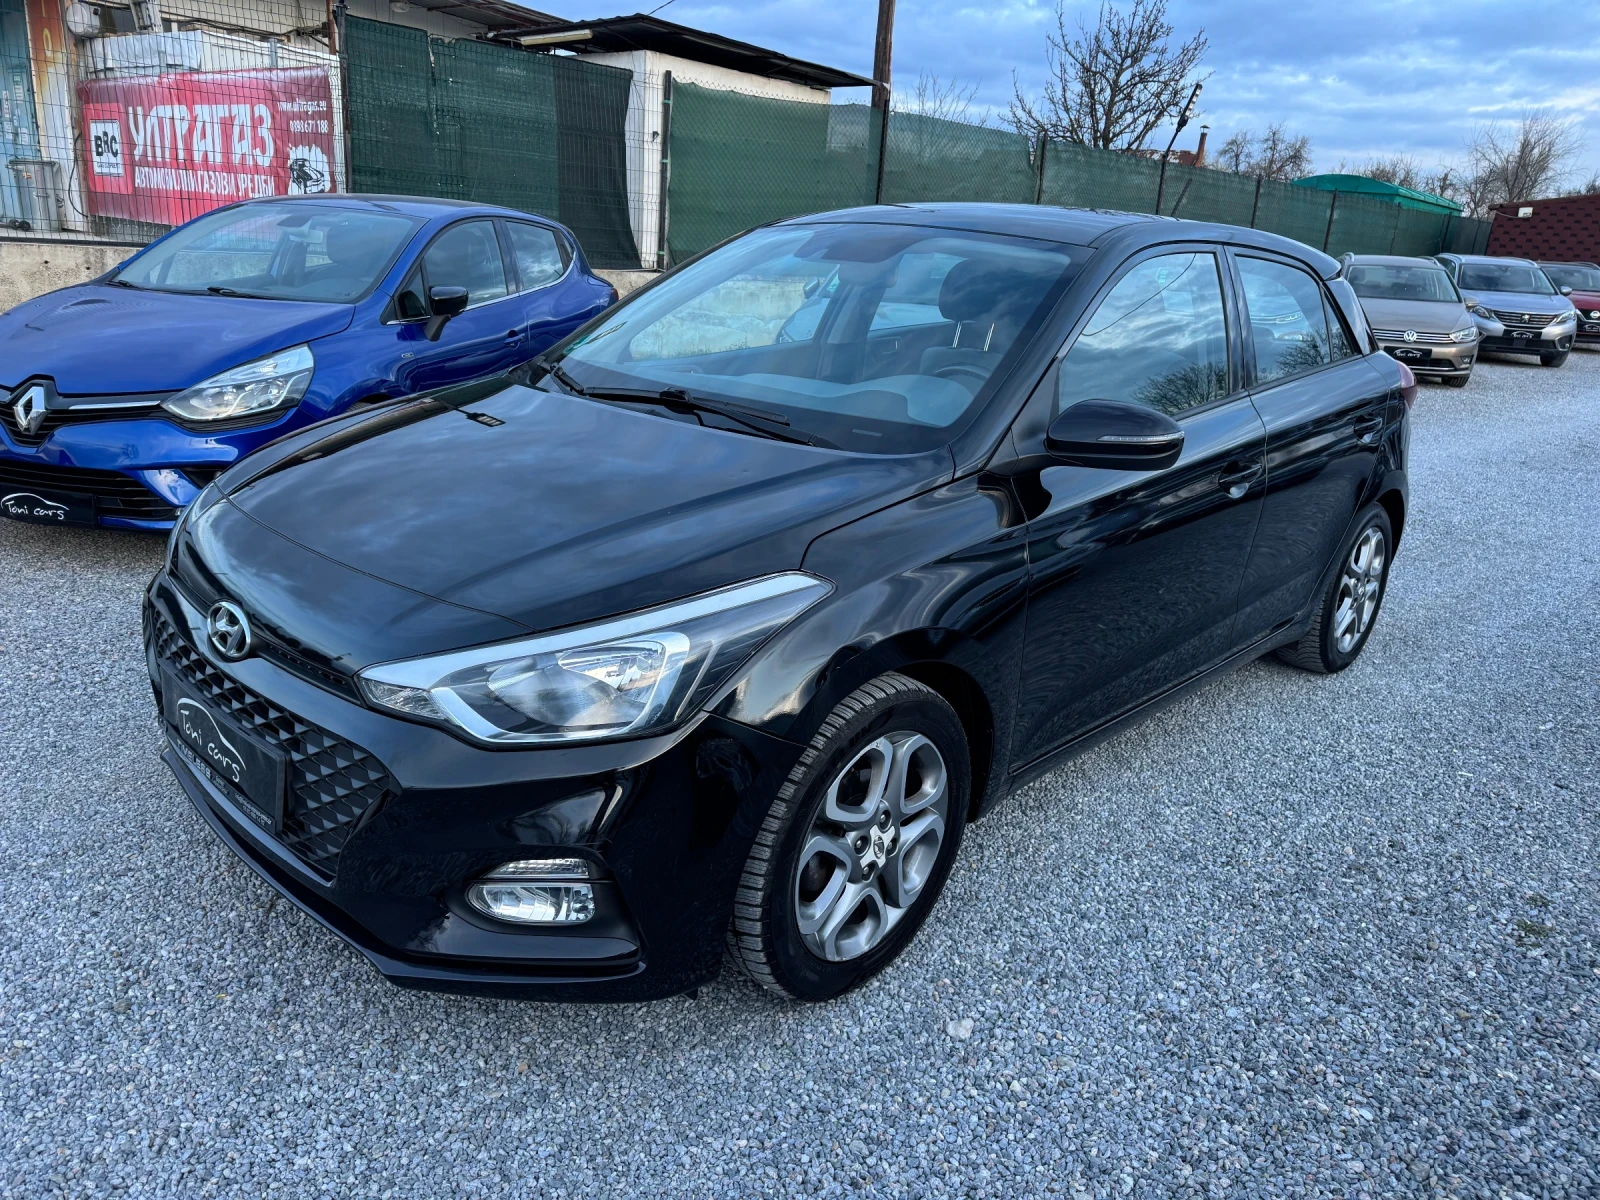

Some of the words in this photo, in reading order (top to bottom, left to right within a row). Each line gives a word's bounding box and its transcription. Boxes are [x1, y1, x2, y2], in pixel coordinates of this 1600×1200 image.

[128, 103, 275, 168] УЛТРАГАЗ
[316, 119, 328, 133] 188
[94, 130, 118, 158] BRC
[197, 170, 236, 196] ГАЗОВИ
[5, 500, 29, 515] Toni
[33, 507, 65, 520] cars
[180, 709, 202, 746] Toni
[207, 742, 240, 783] cars
